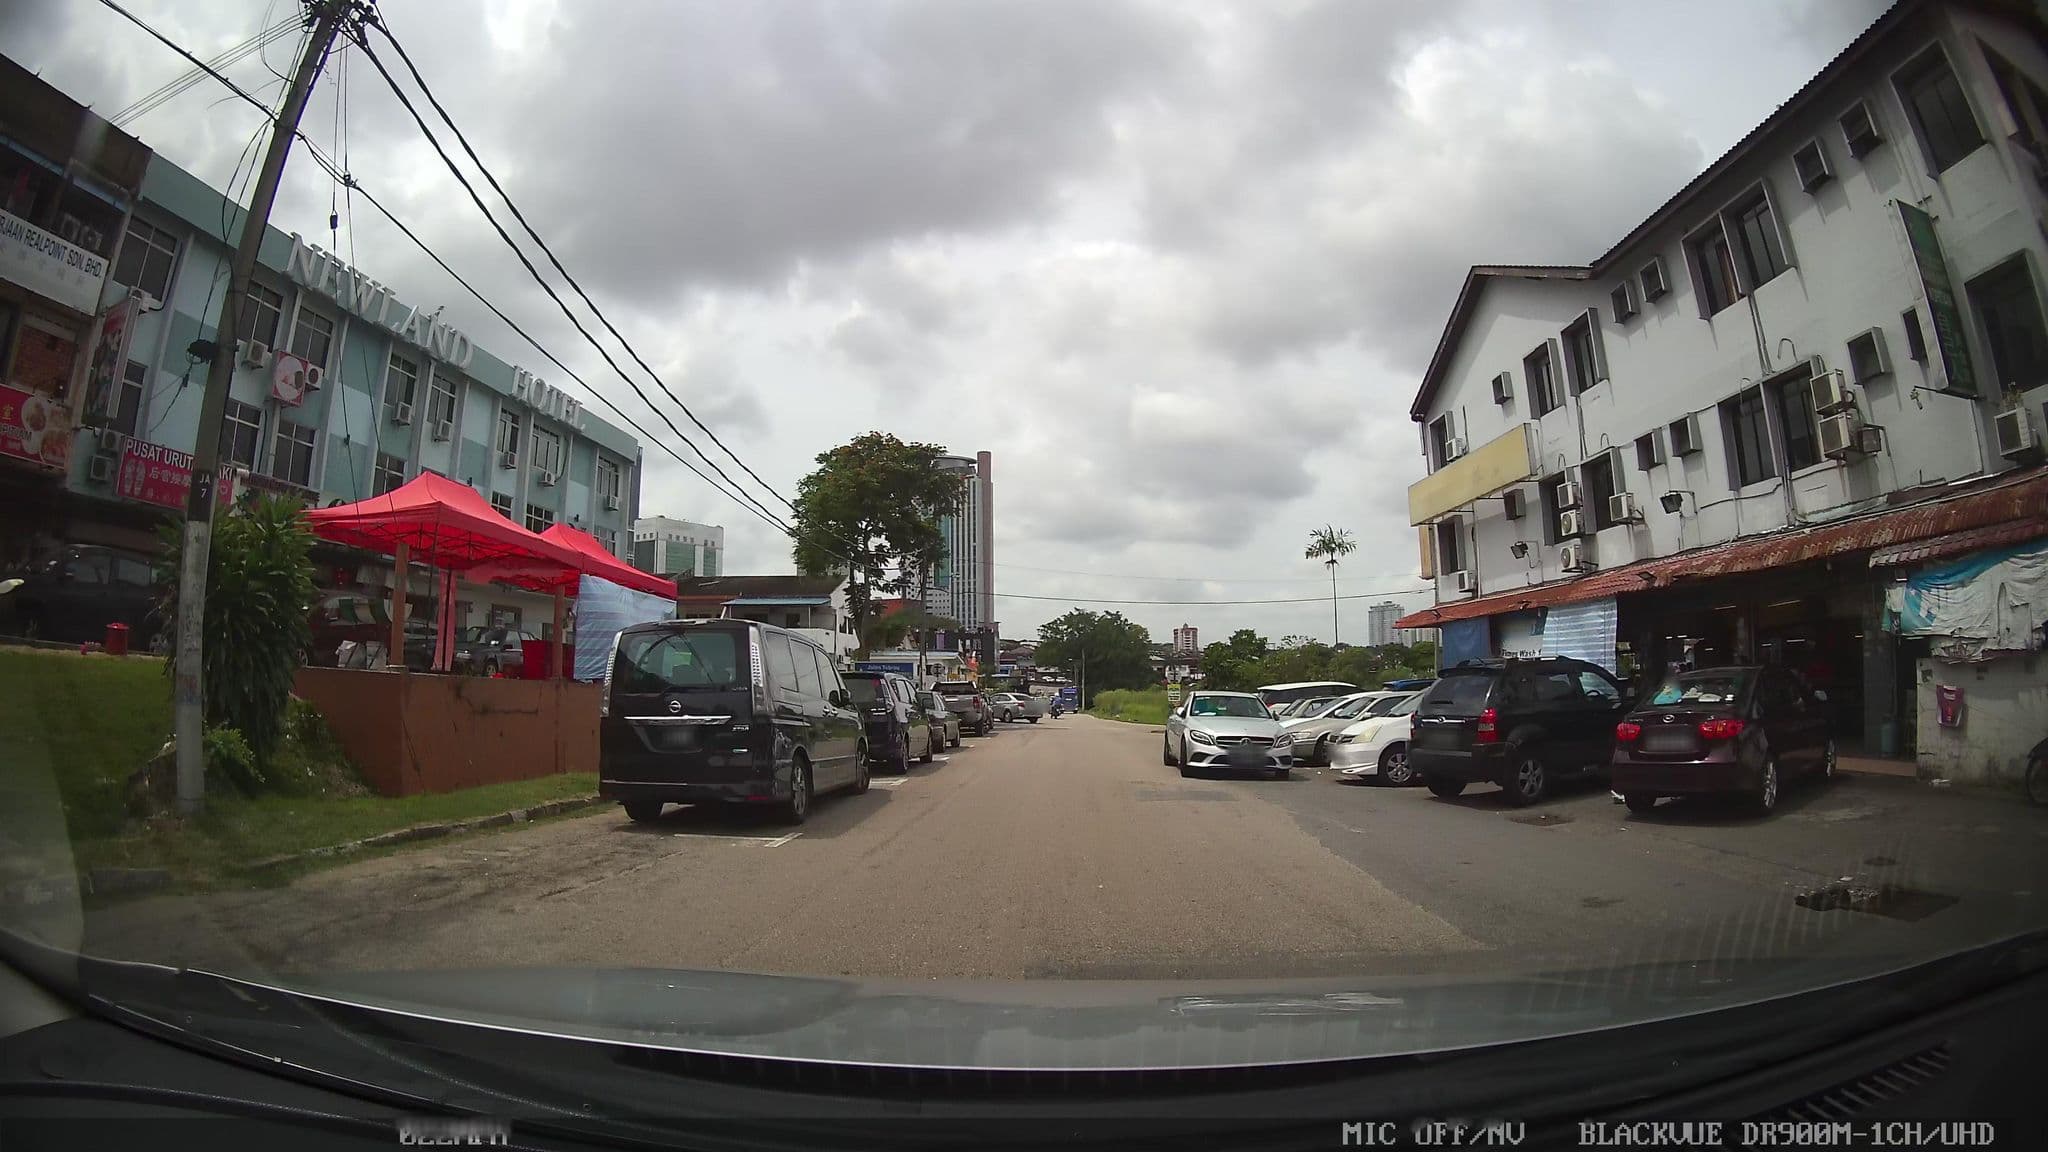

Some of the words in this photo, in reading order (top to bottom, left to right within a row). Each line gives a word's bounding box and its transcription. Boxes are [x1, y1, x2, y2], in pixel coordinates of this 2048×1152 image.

[24, 228, 68, 262] REALPOINT
[67, 249, 85, 271] SDN.
[285, 231, 475, 370] NEWLAND
[510, 364, 586, 432] HOTEL
[125, 439, 163, 463] PUSAT
[163, 449, 194, 471] URUT
[199, 473, 211, 485] JA
[201, 488, 208, 499] 7
